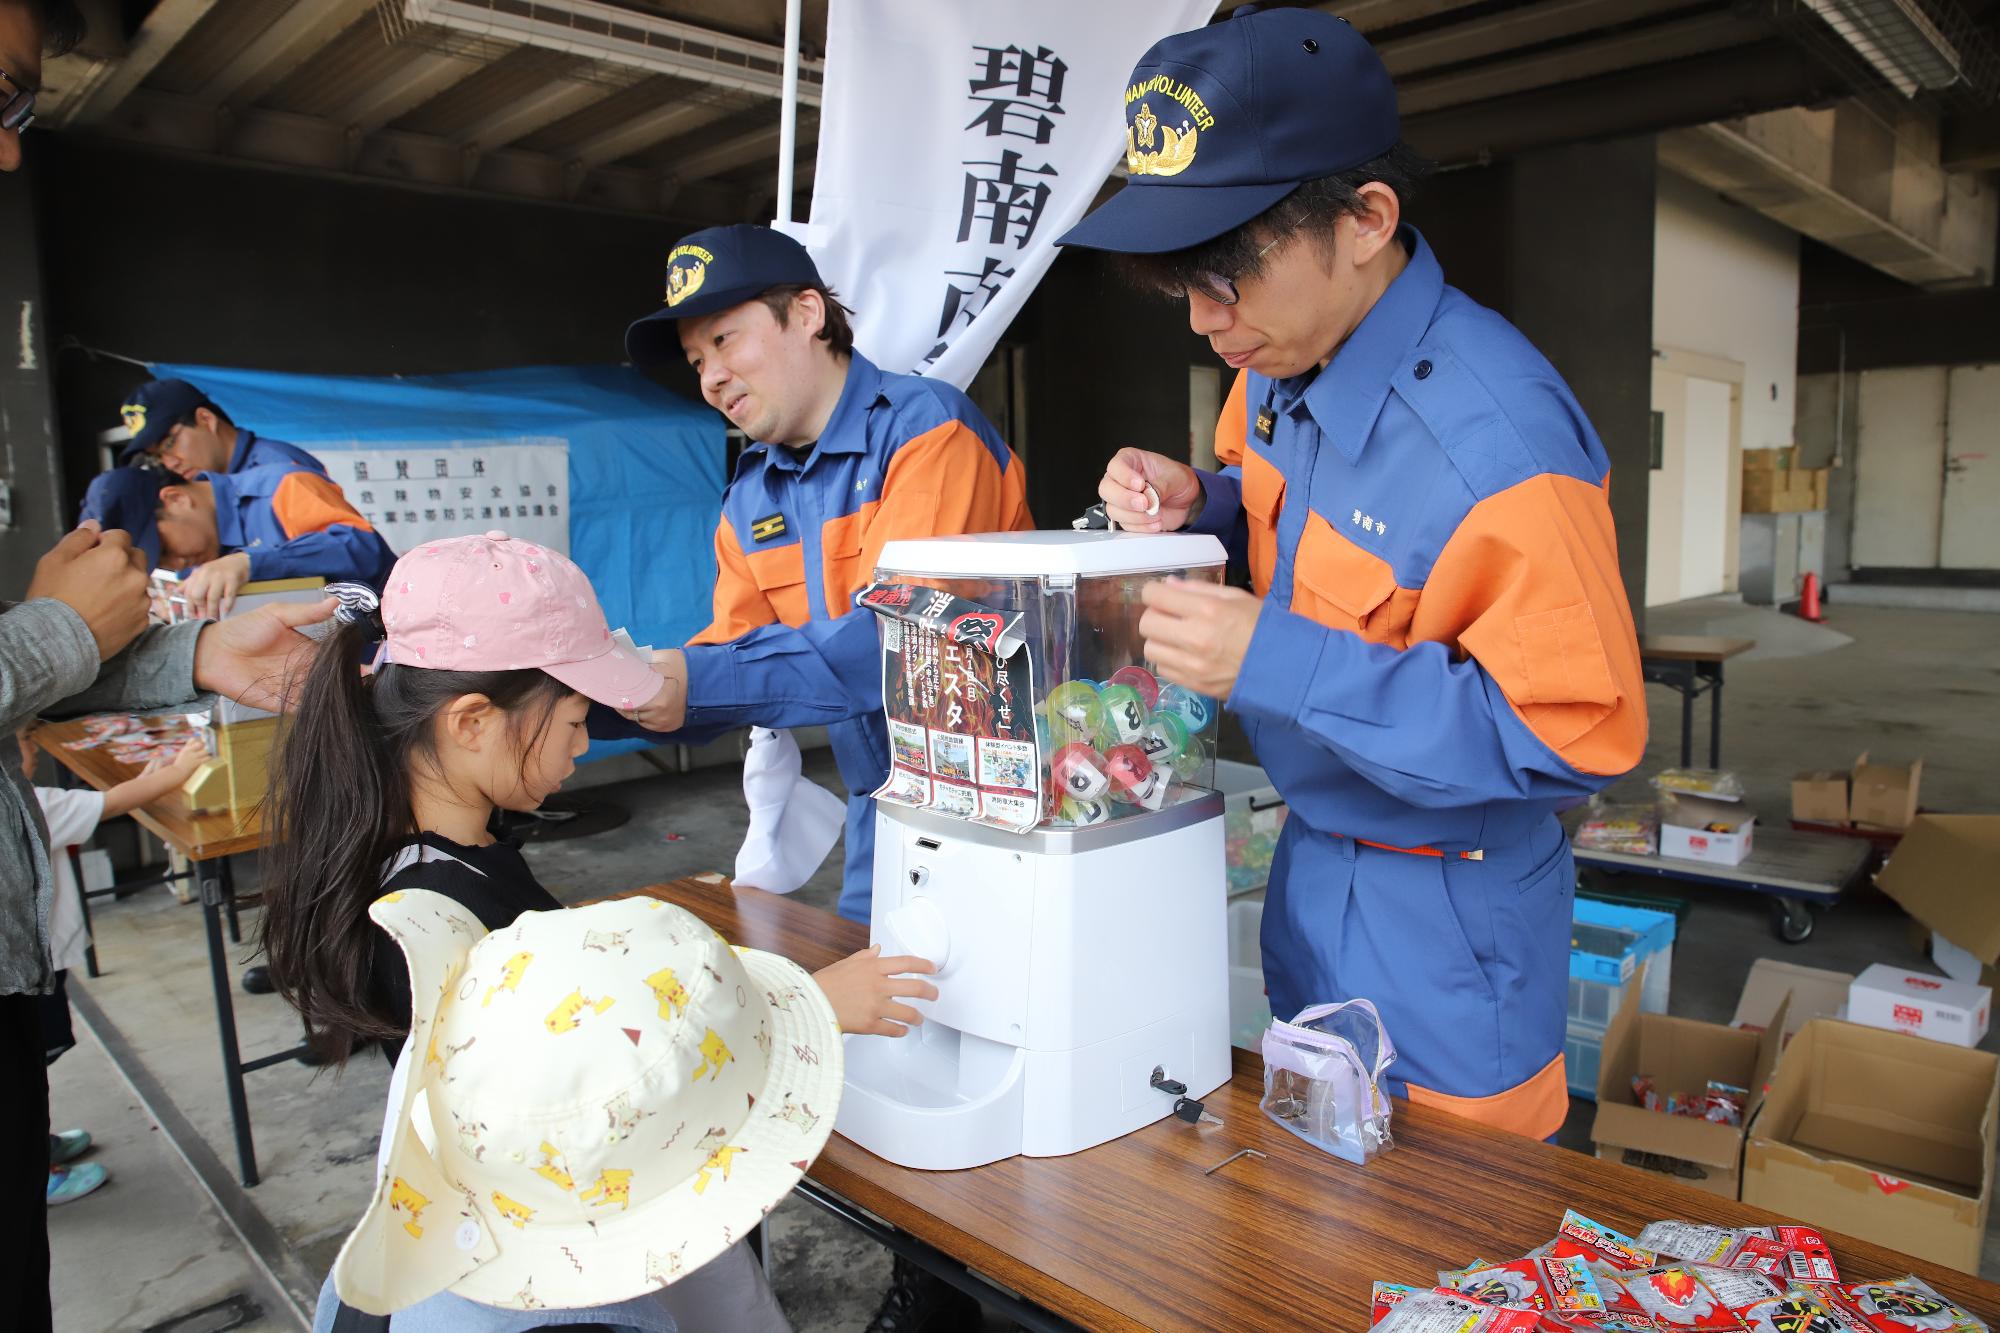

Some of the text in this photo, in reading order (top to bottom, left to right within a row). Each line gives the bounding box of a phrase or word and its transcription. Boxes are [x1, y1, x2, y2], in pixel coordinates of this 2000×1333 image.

[1154, 74, 1215, 132] VOLUNTEER
[354, 458, 485, 480] 協賛団体
